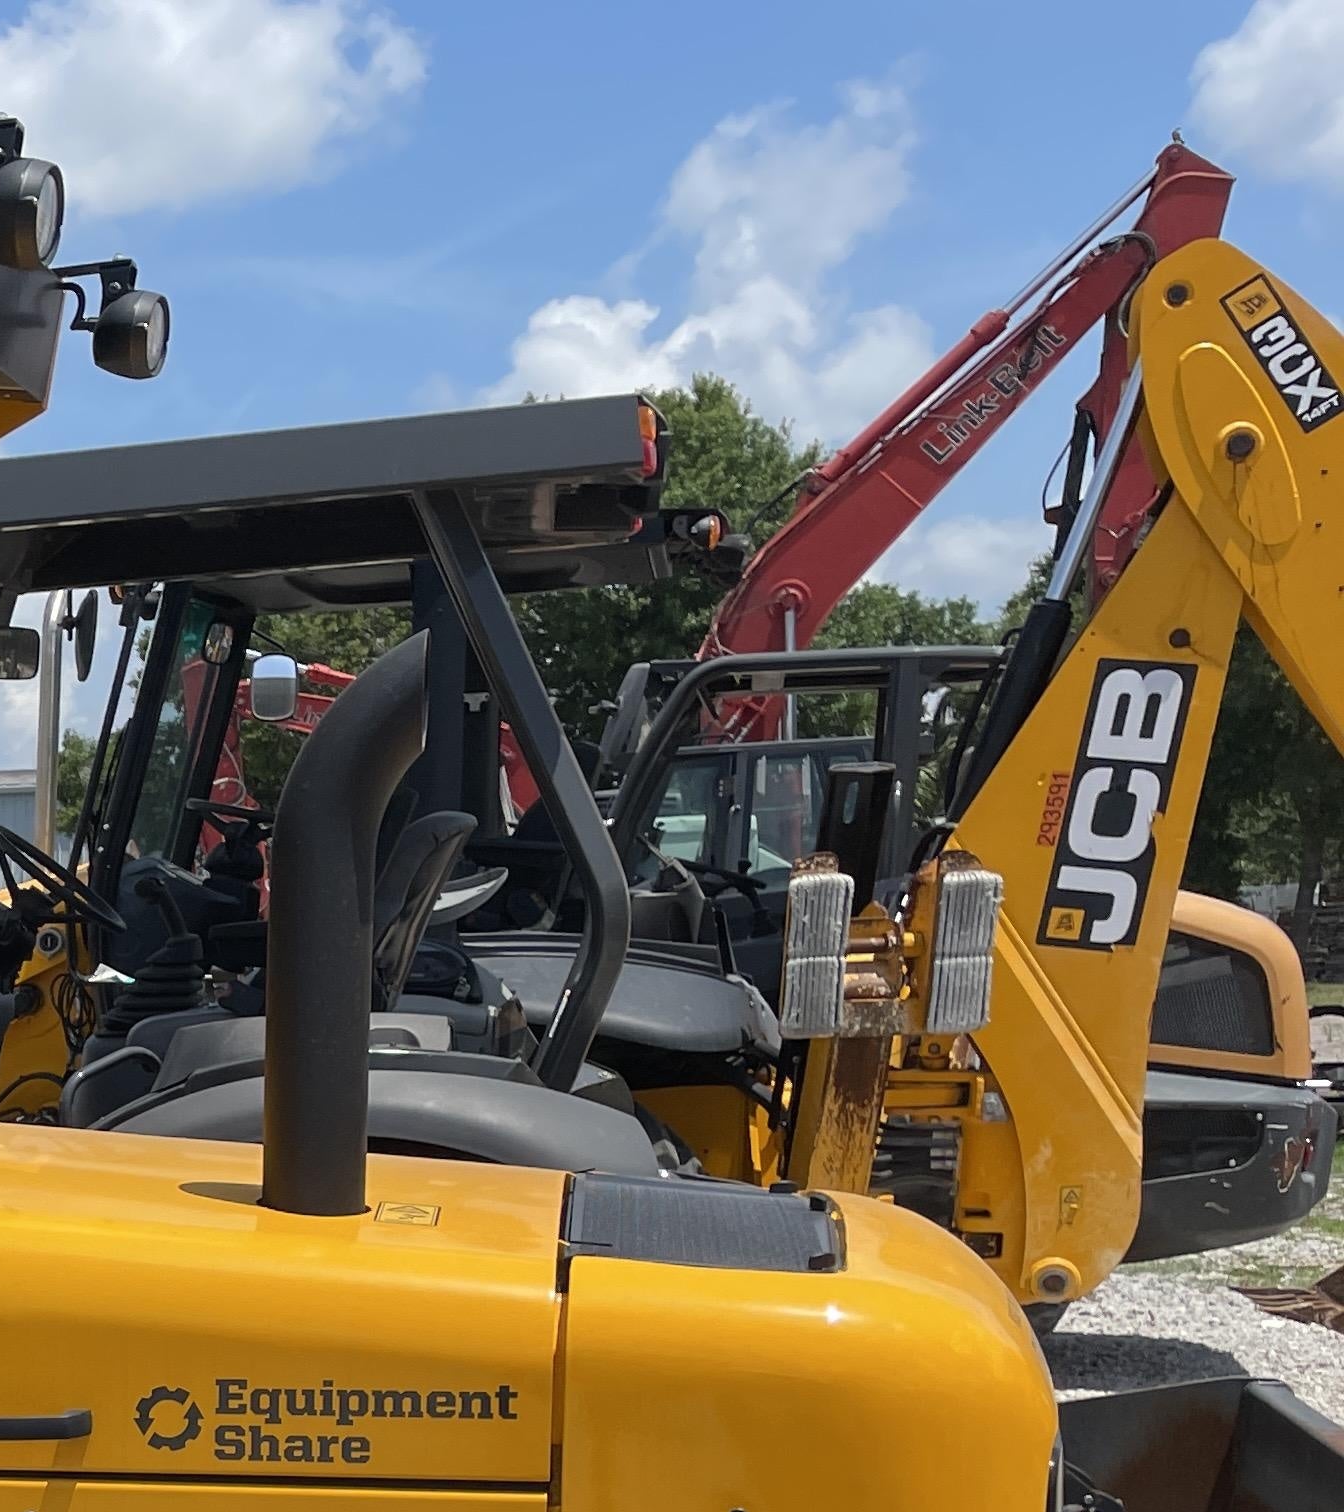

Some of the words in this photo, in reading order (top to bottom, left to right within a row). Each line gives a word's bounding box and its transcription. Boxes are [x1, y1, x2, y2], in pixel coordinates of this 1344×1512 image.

[920, 325, 1068, 464] Link-Belt
[1250, 315, 1338, 416] 3CX
[1037, 771, 1070, 847] 293591
[1056, 668, 1184, 944] JCB
[215, 1379, 518, 1426] Equipment
[215, 1425, 371, 1464] Share
